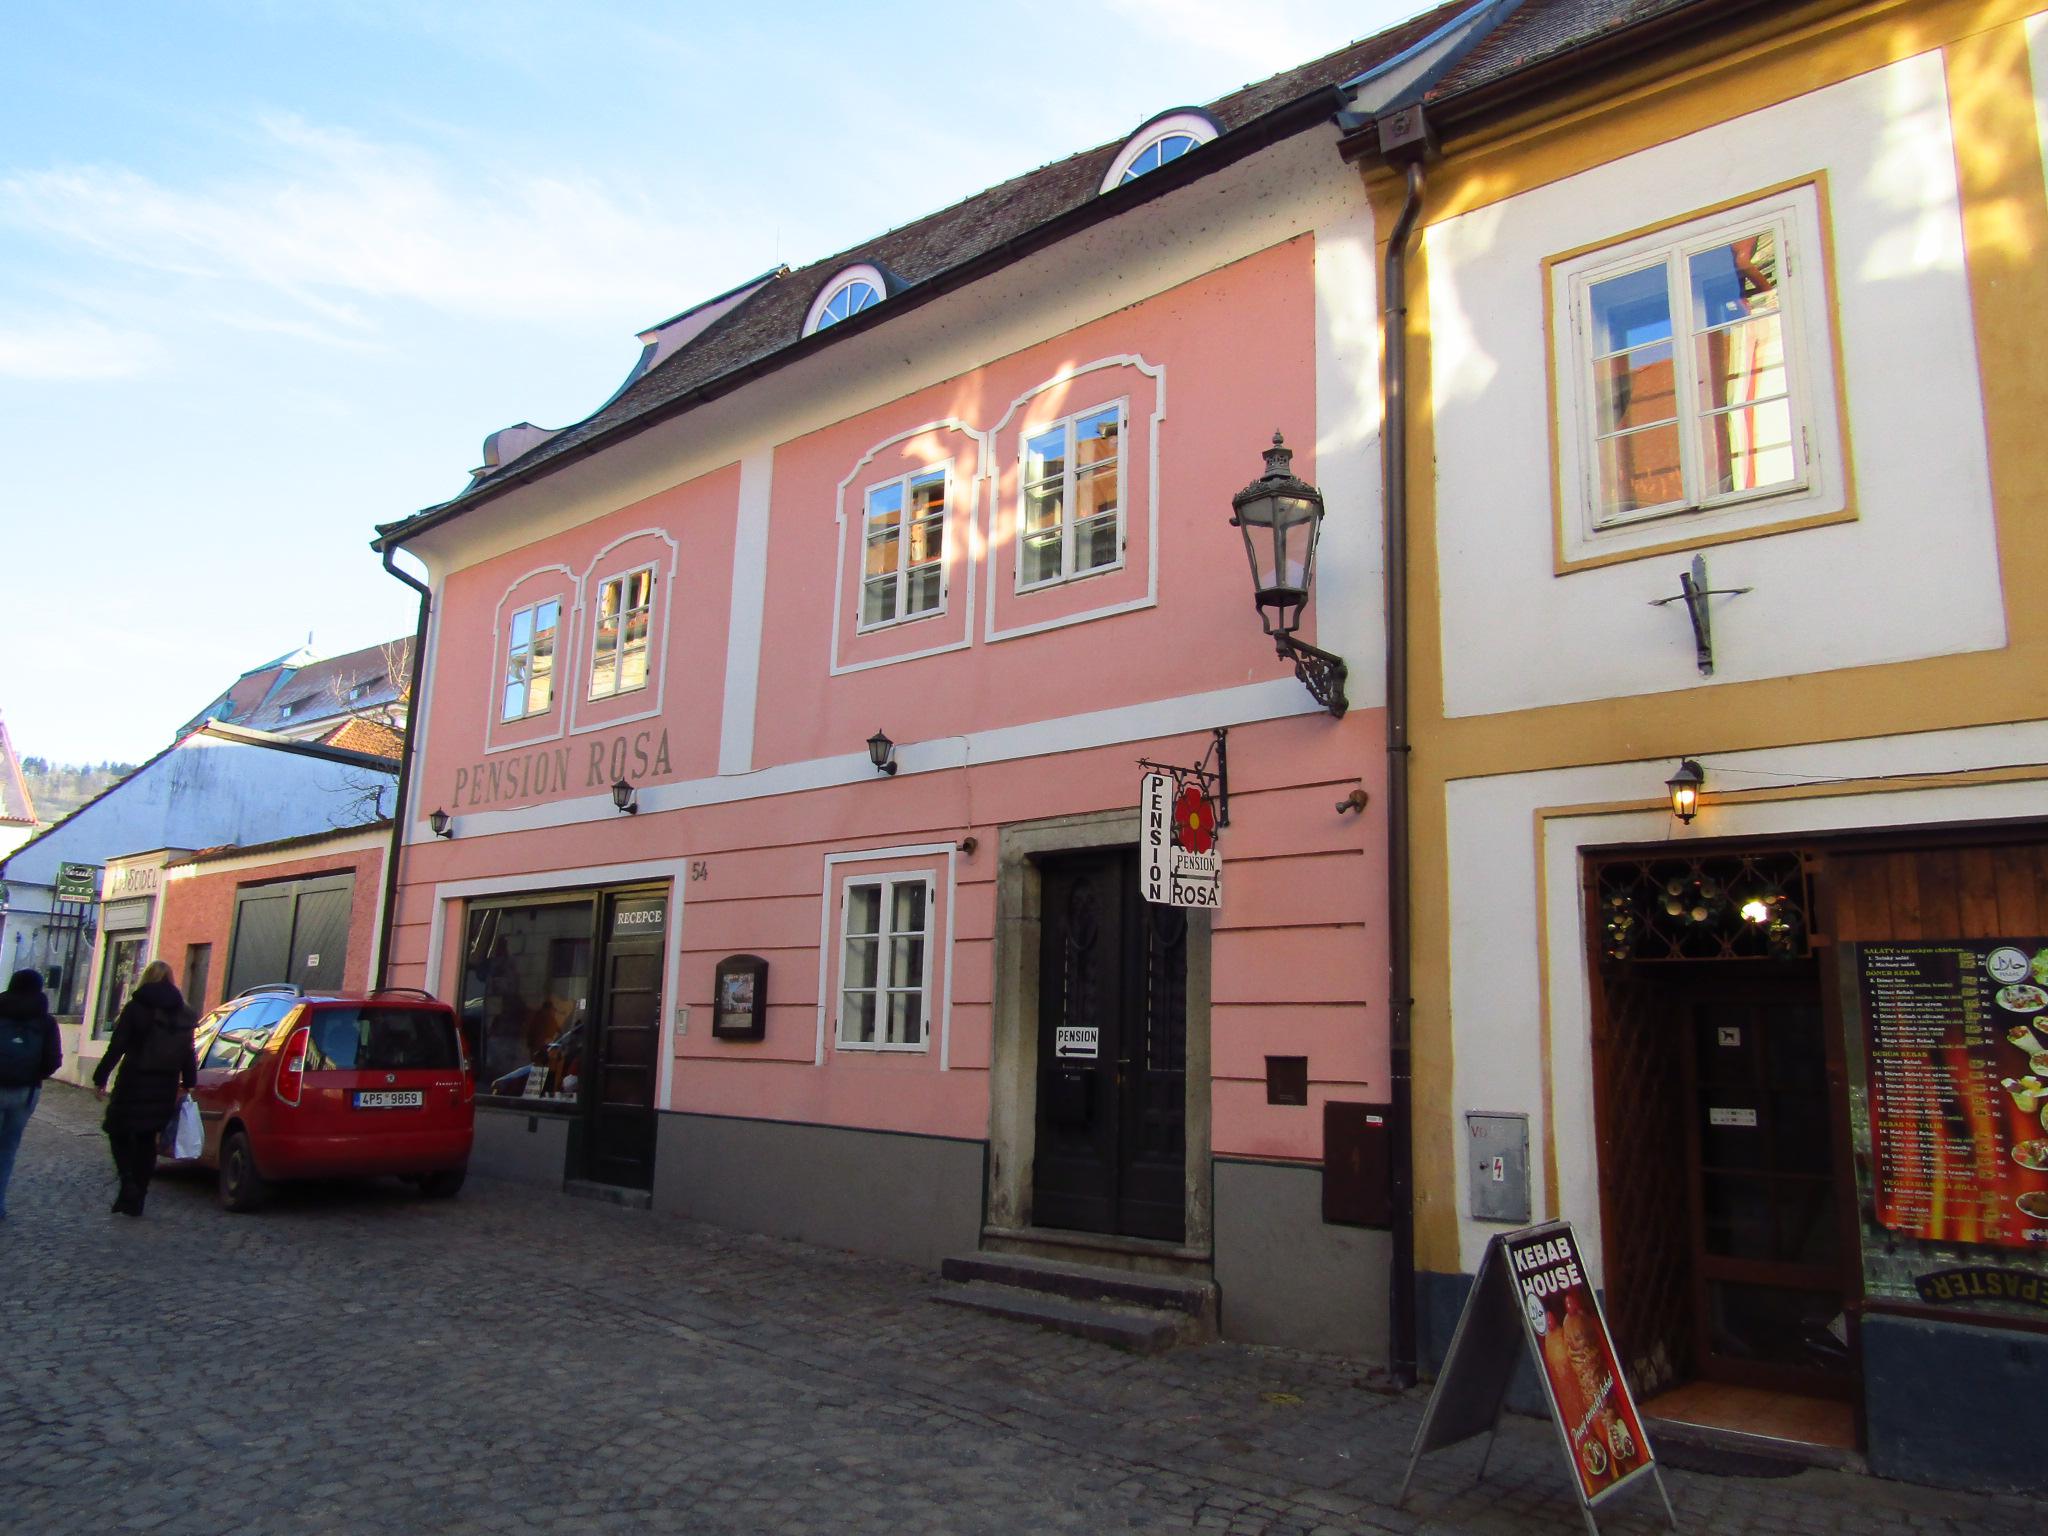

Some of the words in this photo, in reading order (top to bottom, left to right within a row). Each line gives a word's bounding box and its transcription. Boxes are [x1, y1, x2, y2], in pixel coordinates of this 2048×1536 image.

[452, 747, 571, 808] PENSION
[586, 727, 672, 787] ROSA
[1150, 776, 1163, 900] PENSION
[691, 861, 708, 881] 54
[1177, 855, 1215, 872] PENSION
[59, 885, 94, 894] FOTO
[1172, 885, 1218, 906] ROSA
[617, 910, 663, 924] RECEPCE
[1058, 1030, 1096, 1042] PENSION
[362, 1093, 383, 1105] 4P5
[391, 1093, 418, 1105] 9859
[1513, 1237, 1571, 1272] KEBAB
[1522, 1263, 1582, 1297] HOUSE
